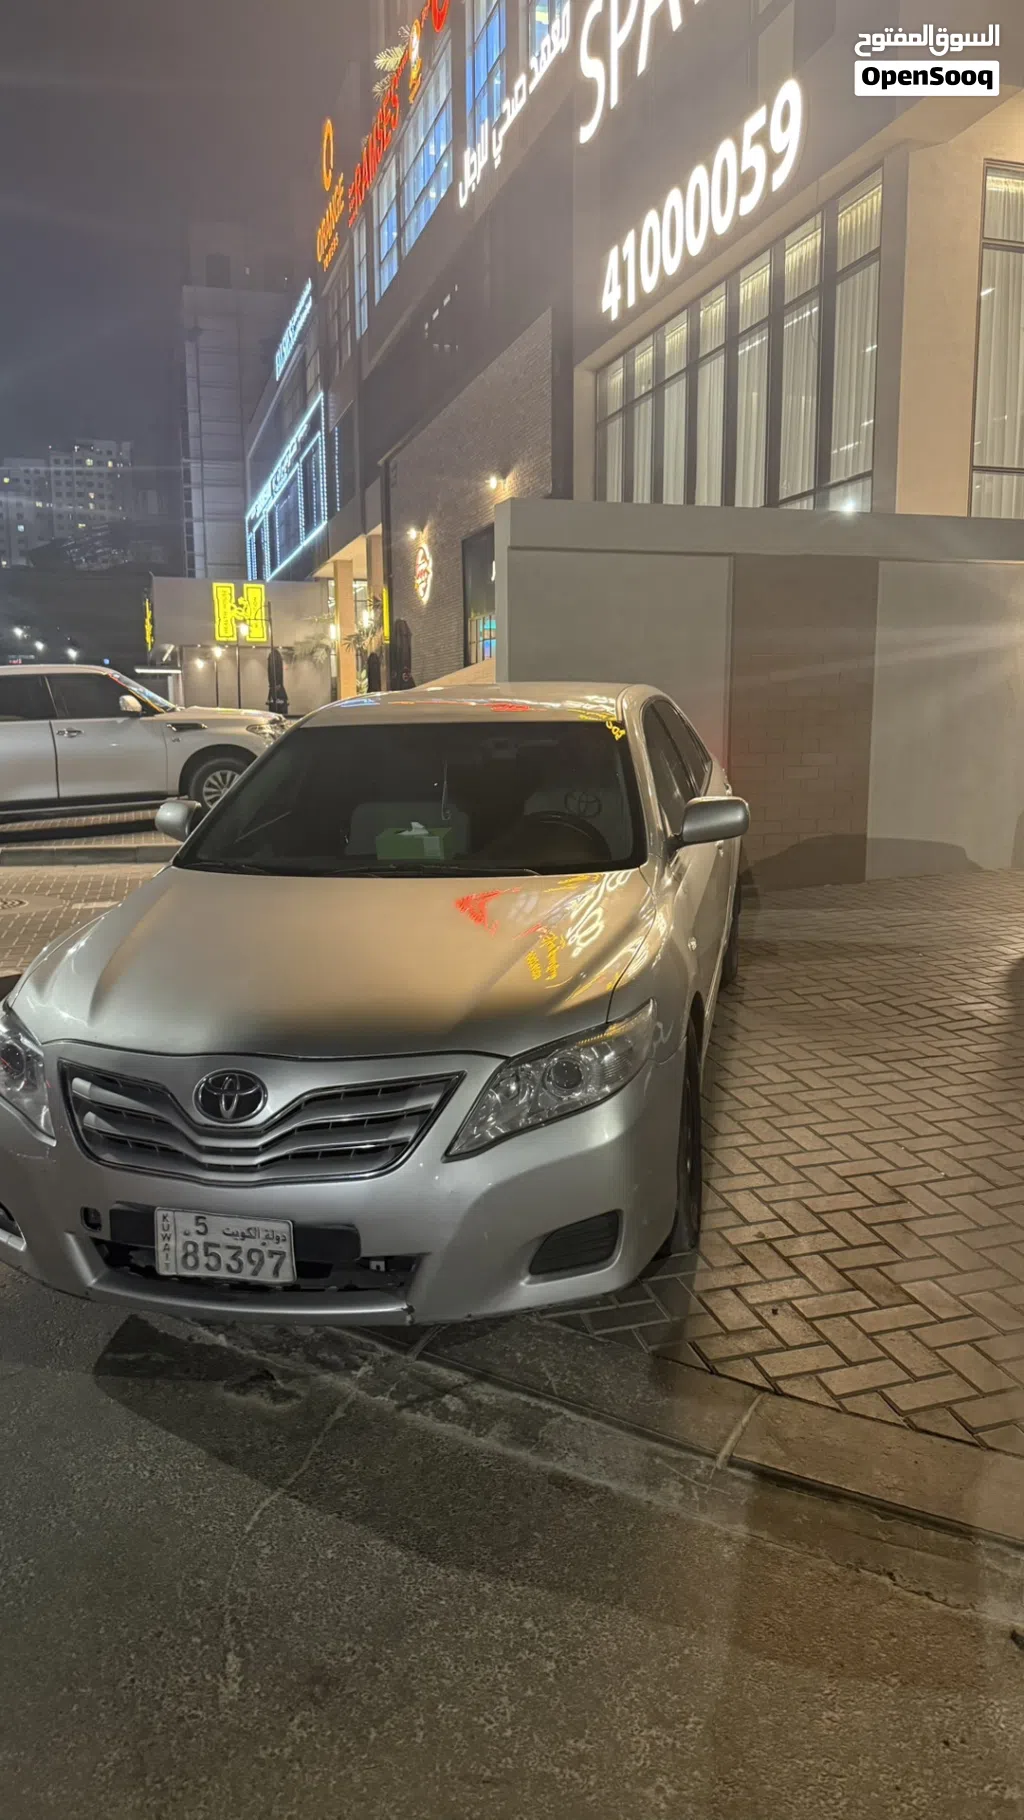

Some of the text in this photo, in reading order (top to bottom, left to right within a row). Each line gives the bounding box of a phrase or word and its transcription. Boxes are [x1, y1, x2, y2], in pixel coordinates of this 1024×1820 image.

[528, 2, 571, 95] معهد
[492, 72, 527, 170] صحي
[601, 78, 802, 322] 41000059
[160, 1213, 172, 1273] KUWAIT
[195, 1215, 209, 1236] 5
[222, 1226, 288, 1244] دولة الكويت
[181, 1240, 288, 1279] 85397
